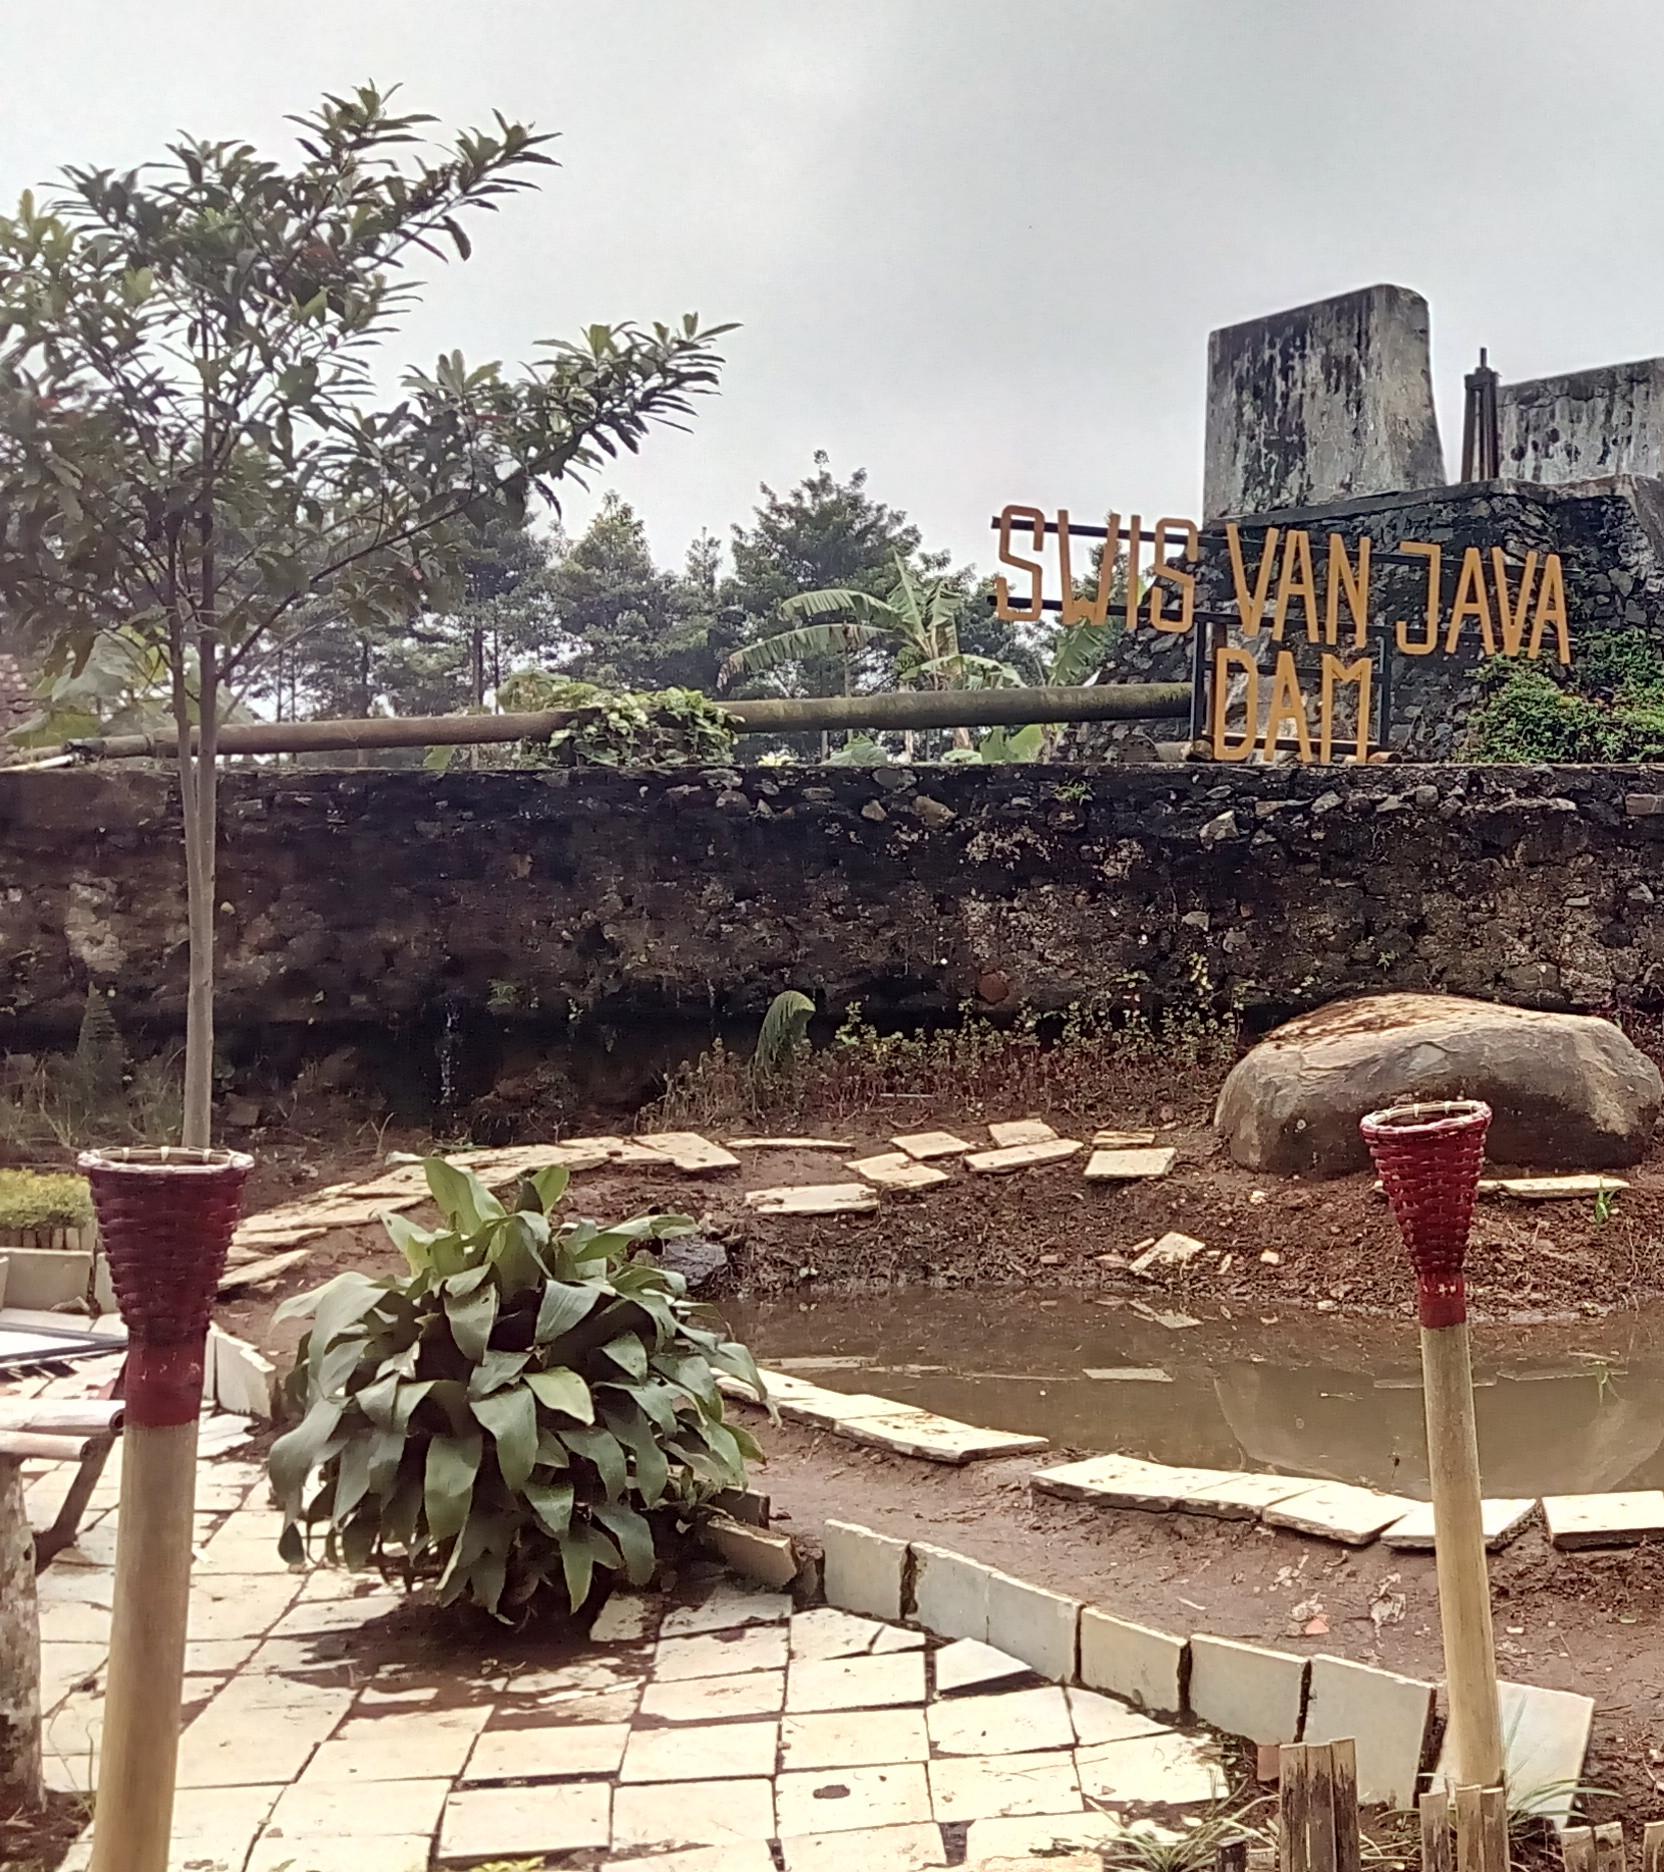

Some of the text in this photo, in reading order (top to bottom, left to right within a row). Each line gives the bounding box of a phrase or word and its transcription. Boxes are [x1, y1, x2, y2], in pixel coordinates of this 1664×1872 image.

[996, 504, 1570, 664] SWIS VAN JAVA
[1213, 648, 1373, 763] DAM
